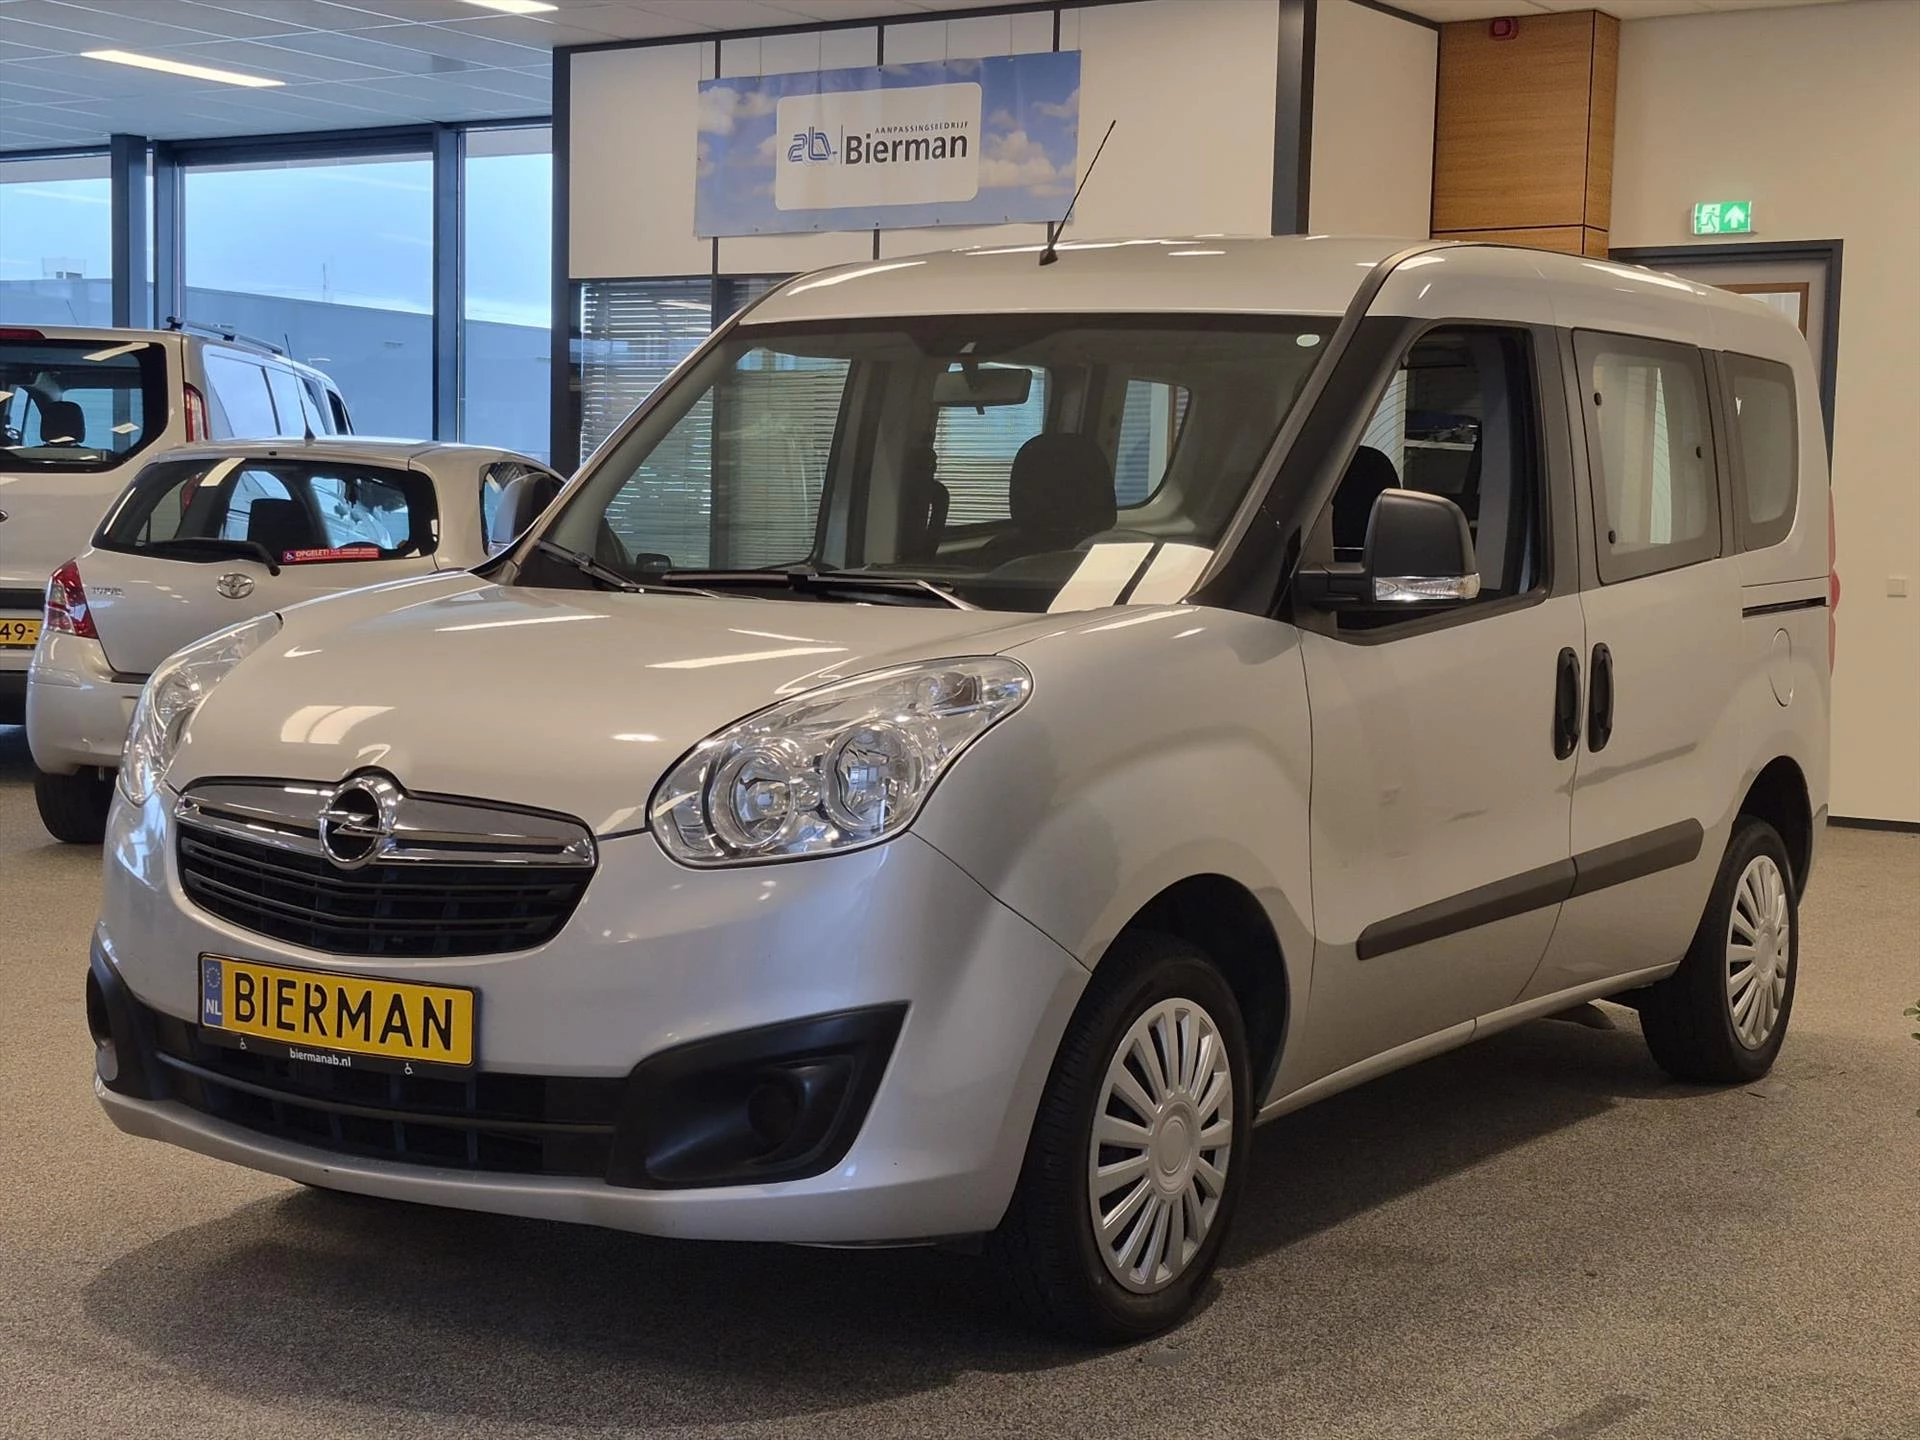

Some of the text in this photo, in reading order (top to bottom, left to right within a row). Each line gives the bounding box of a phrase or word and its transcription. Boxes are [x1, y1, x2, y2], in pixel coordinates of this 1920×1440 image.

[875, 121, 969, 134] AANPASSINGSBEDRIJF
[845, 133, 968, 165] Bierman
[206, 999, 222, 1016] NL
[234, 972, 453, 1051] BIERMAN
[289, 1048, 351, 1067] biermanab.nl
